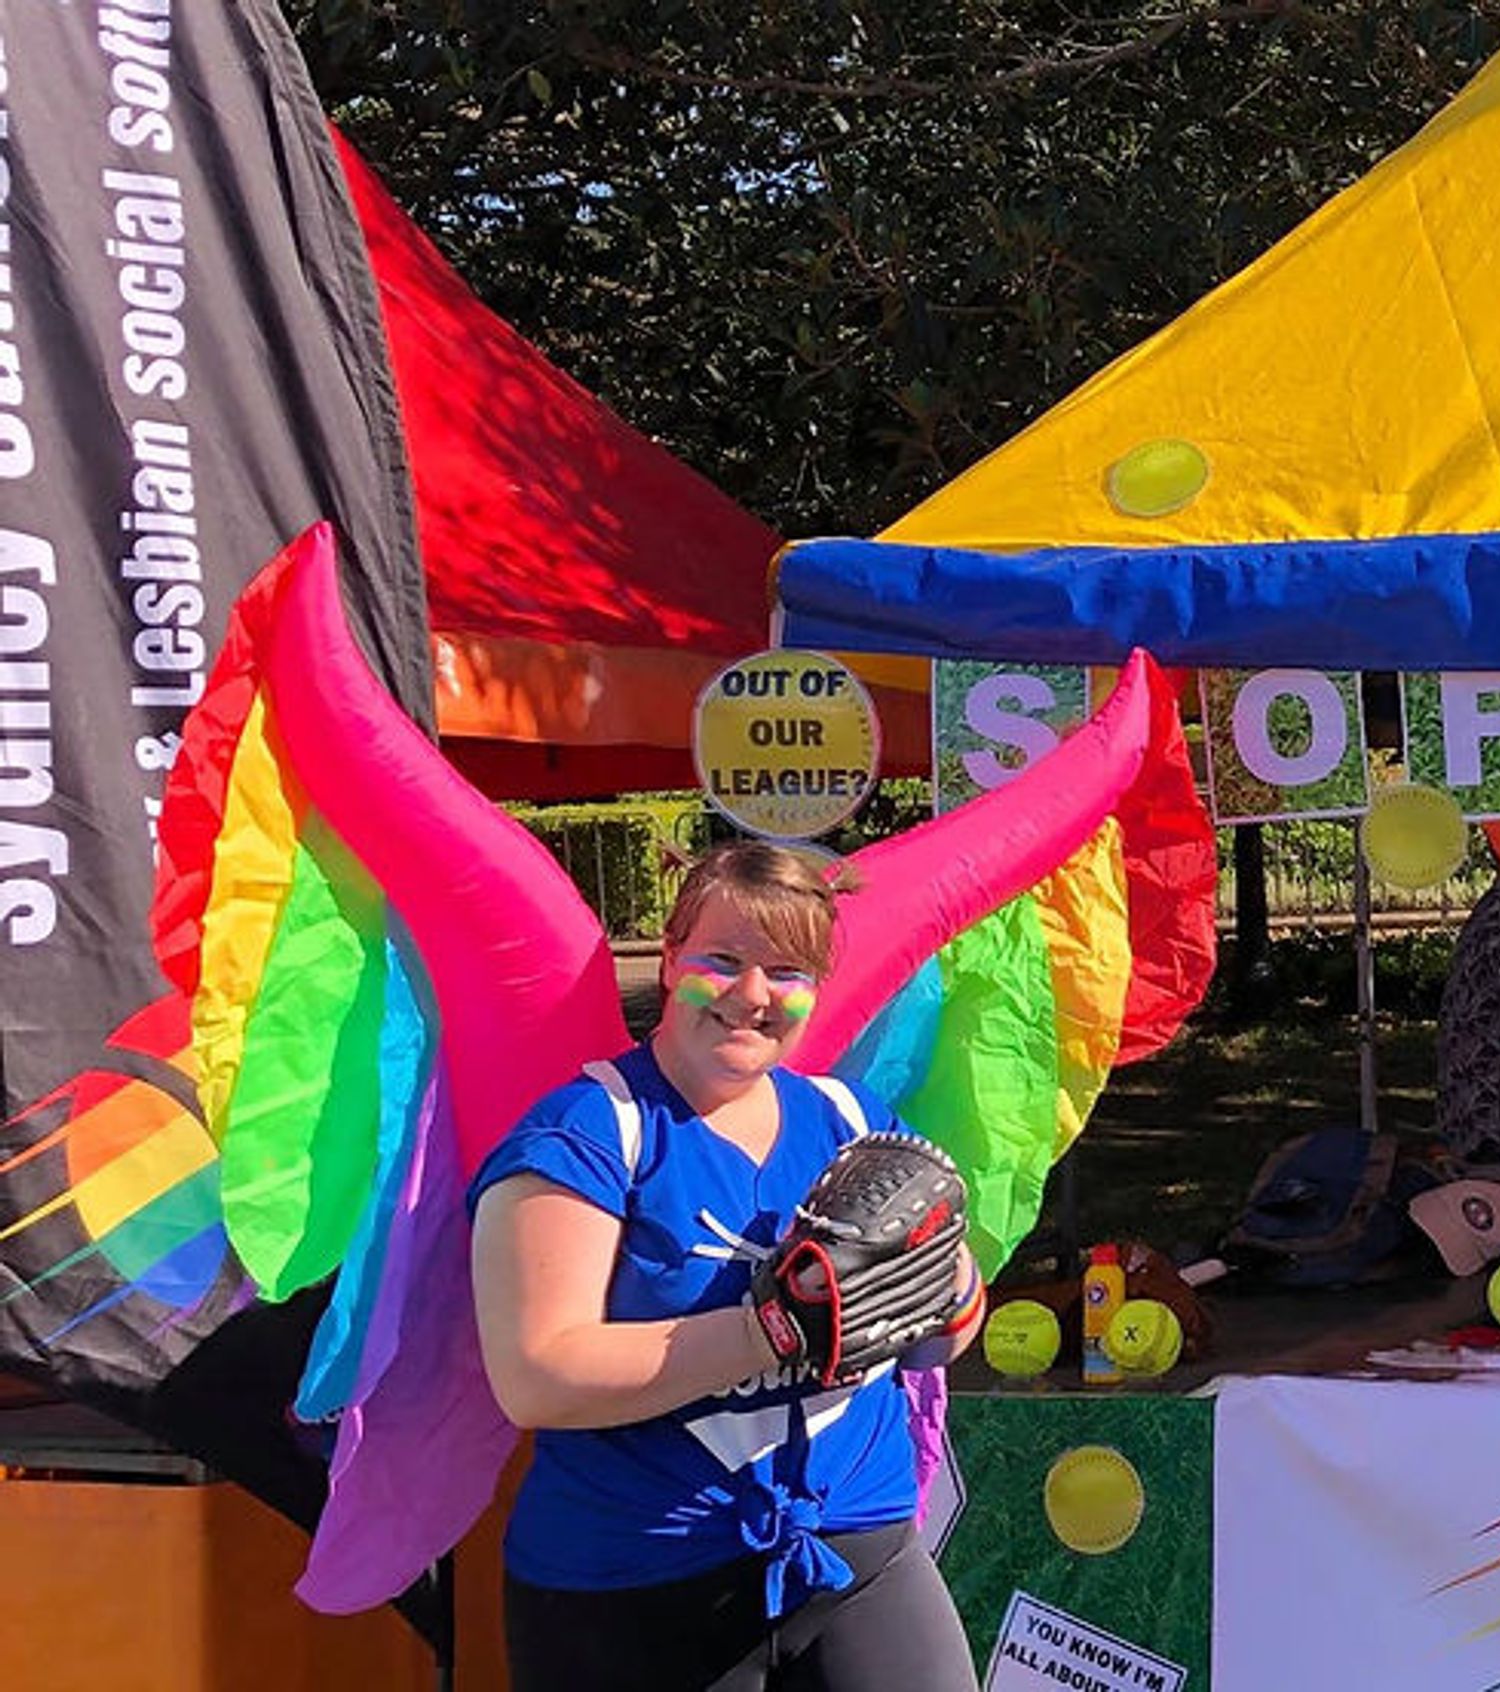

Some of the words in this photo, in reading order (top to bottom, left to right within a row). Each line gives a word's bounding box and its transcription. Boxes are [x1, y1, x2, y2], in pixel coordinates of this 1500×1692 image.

[102, 168, 188, 400] social
[121, 418, 206, 706] Lesbian
[720, 670, 791, 697] OUT
[799, 670, 847, 697] OF
[748, 719, 824, 747] OUR
[710, 768, 869, 796] LEAGUE?
[1004, 1642, 1040, 1671] ALL
[1026, 1615, 1067, 1647] YOU
[1068, 1636, 1132, 1677] KNOW
